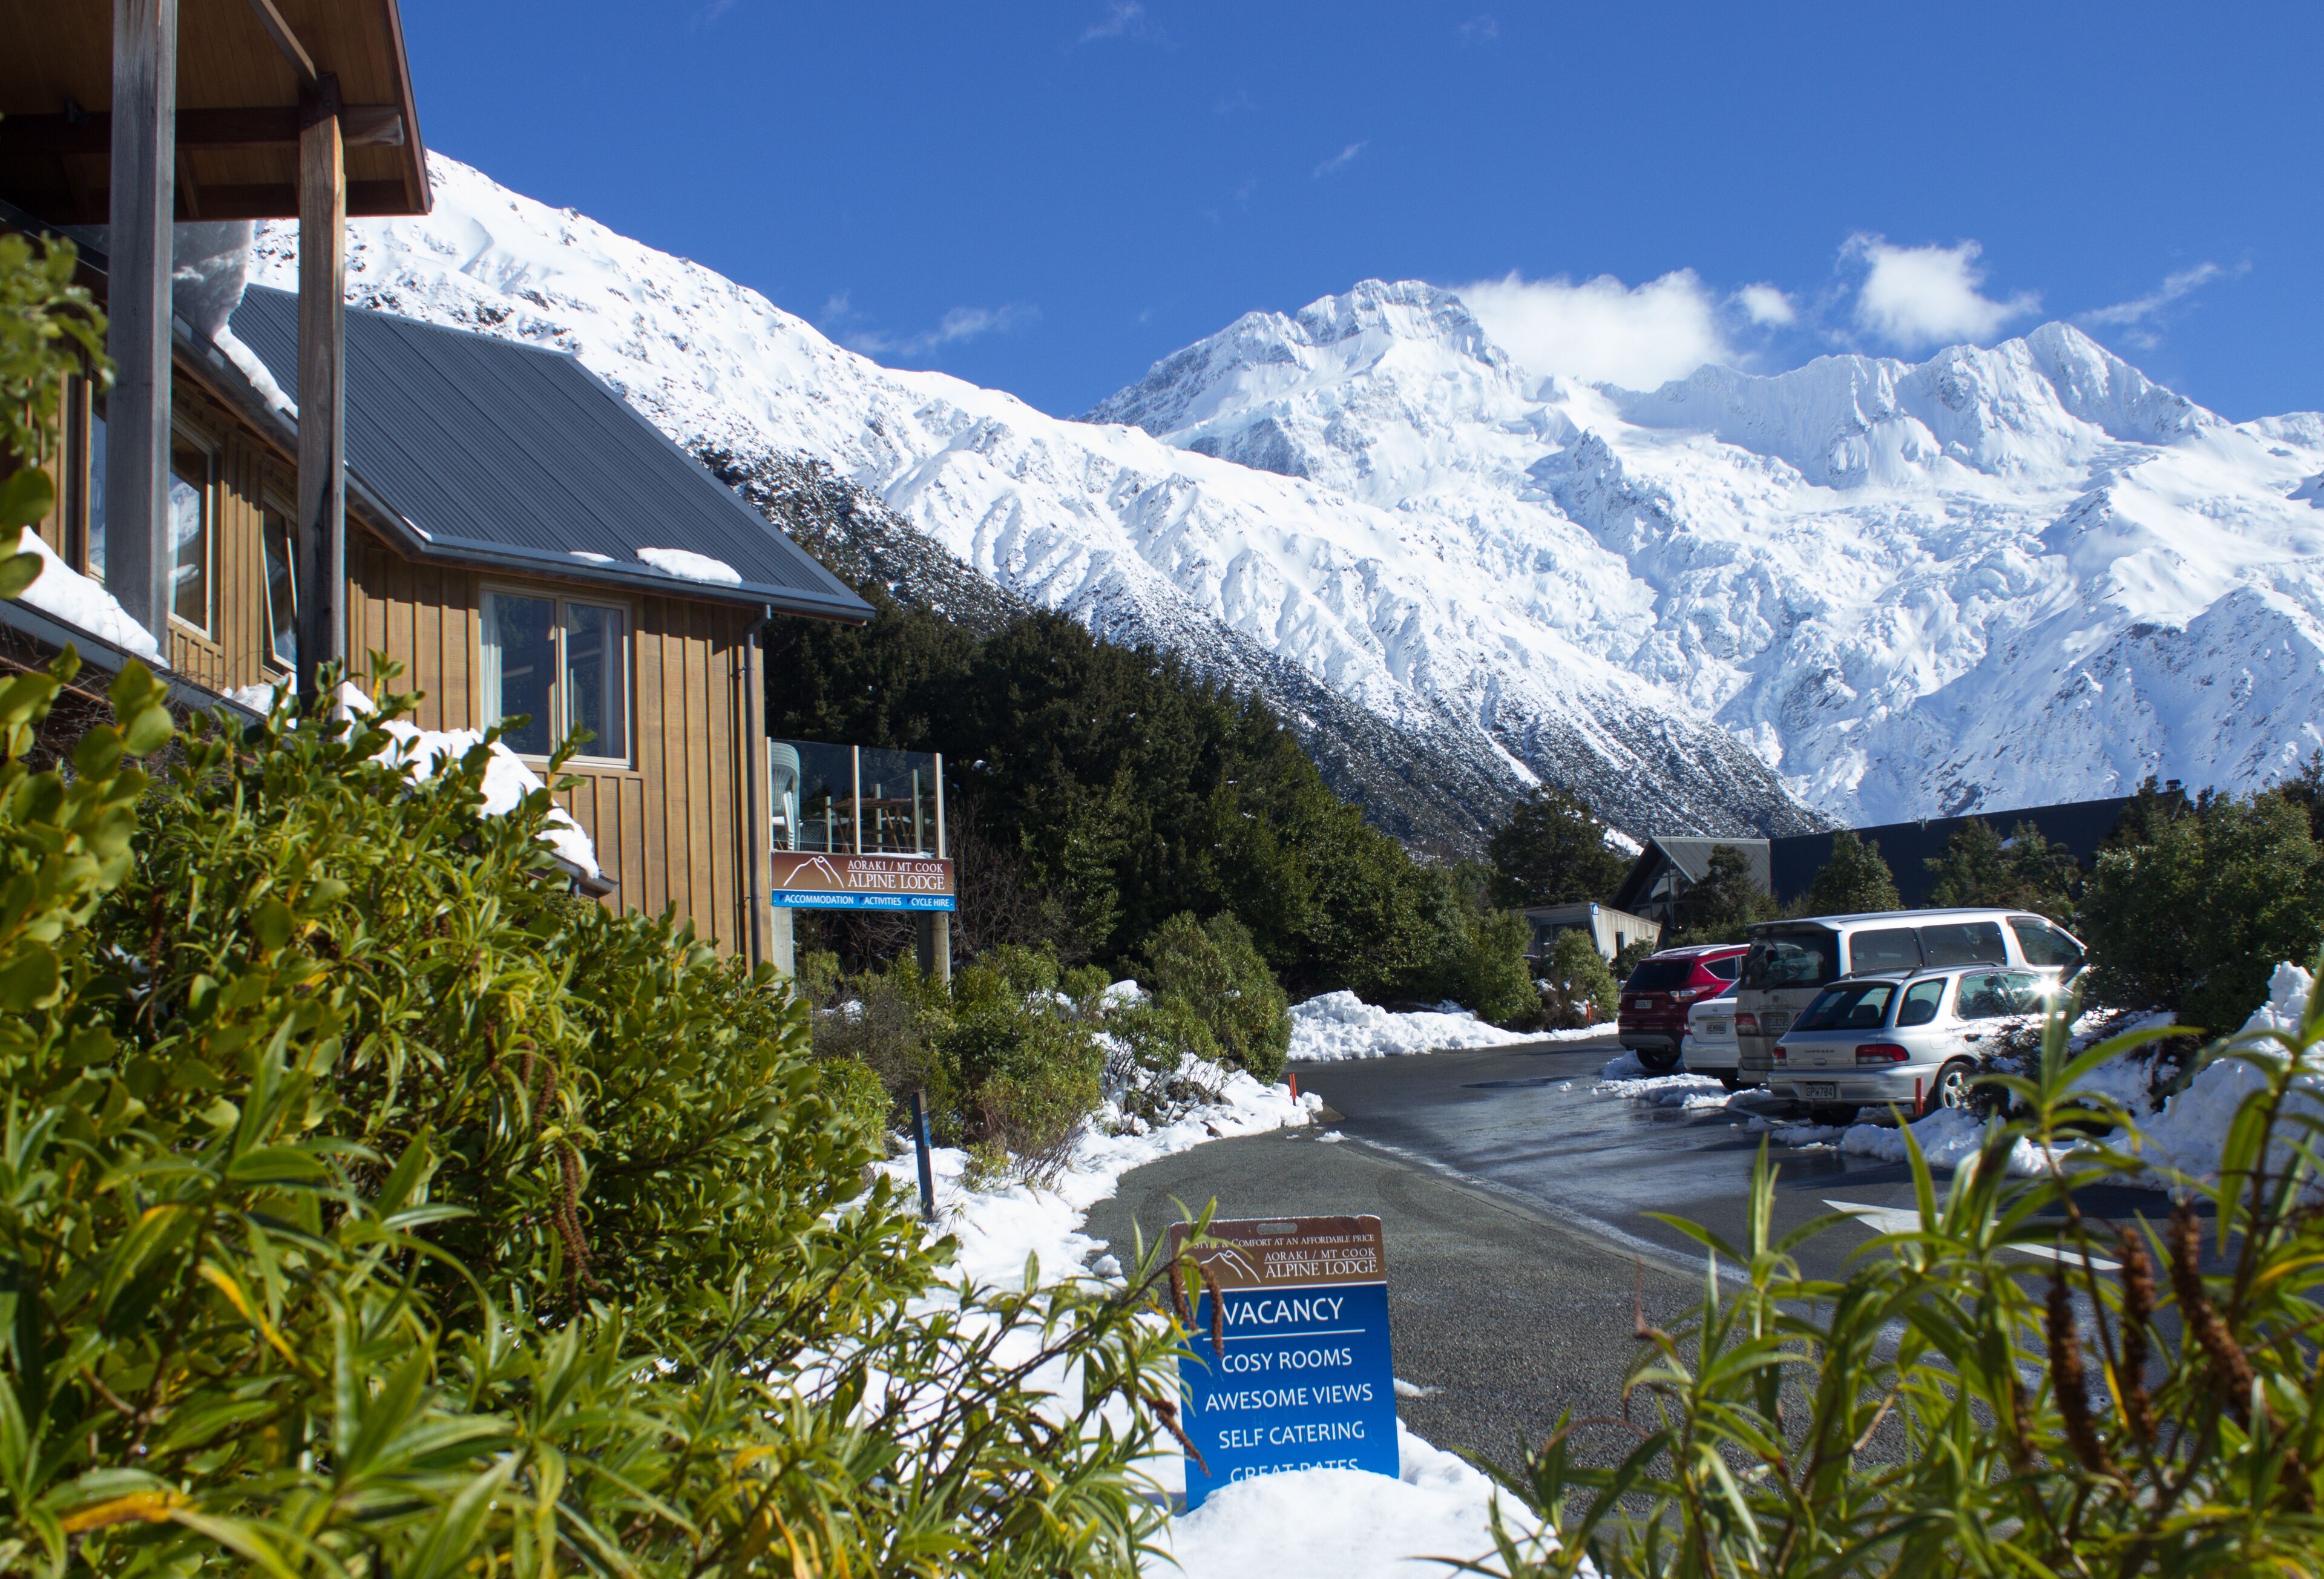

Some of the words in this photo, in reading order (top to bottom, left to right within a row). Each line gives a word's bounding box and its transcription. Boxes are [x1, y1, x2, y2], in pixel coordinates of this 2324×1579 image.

[847, 860, 886, 871] AORAKI
[889, 861, 894, 872] /
[897, 862, 912, 872] MT
[915, 862, 944, 873] COOK
[847, 873, 896, 888] ALPINE
[900, 875, 945, 890] LODGE
[784, 895, 854, 905] ACCOMMODATION
[864, 896, 902, 906] ACTIVITIES
[910, 898, 933, 907] CYCLE
[933, 898, 950, 907] HIRE
[1231, 1238, 1272, 1248] COMFORT
[1274, 1238, 1284, 1246] AT
[1286, 1236, 1299, 1246] AN
[1301, 1235, 1351, 1245] AFFORDABLE
[1353, 1234, 1375, 1243] PRICE
[1264, 1250, 1308, 1261] AORAKI
[1312, 1249, 1317, 1260] /
[1321, 1249, 1338, 1259] MT
[1341, 1247, 1376, 1258] COOK
[1265, 1262, 1321, 1278] ALPINE
[1325, 1259, 1379, 1275] LODGE
[1223, 1297, 1344, 1325] VACANCY
[1222, 1352, 1273, 1373] COSY
[1279, 1347, 1353, 1370] ROOMS
[1205, 1387, 1308, 1412] AWESOME
[1312, 1383, 1373, 1404] VIEWS
[1218, 1428, 1264, 1449] SELF
[1269, 1420, 1365, 1445] CATERING
